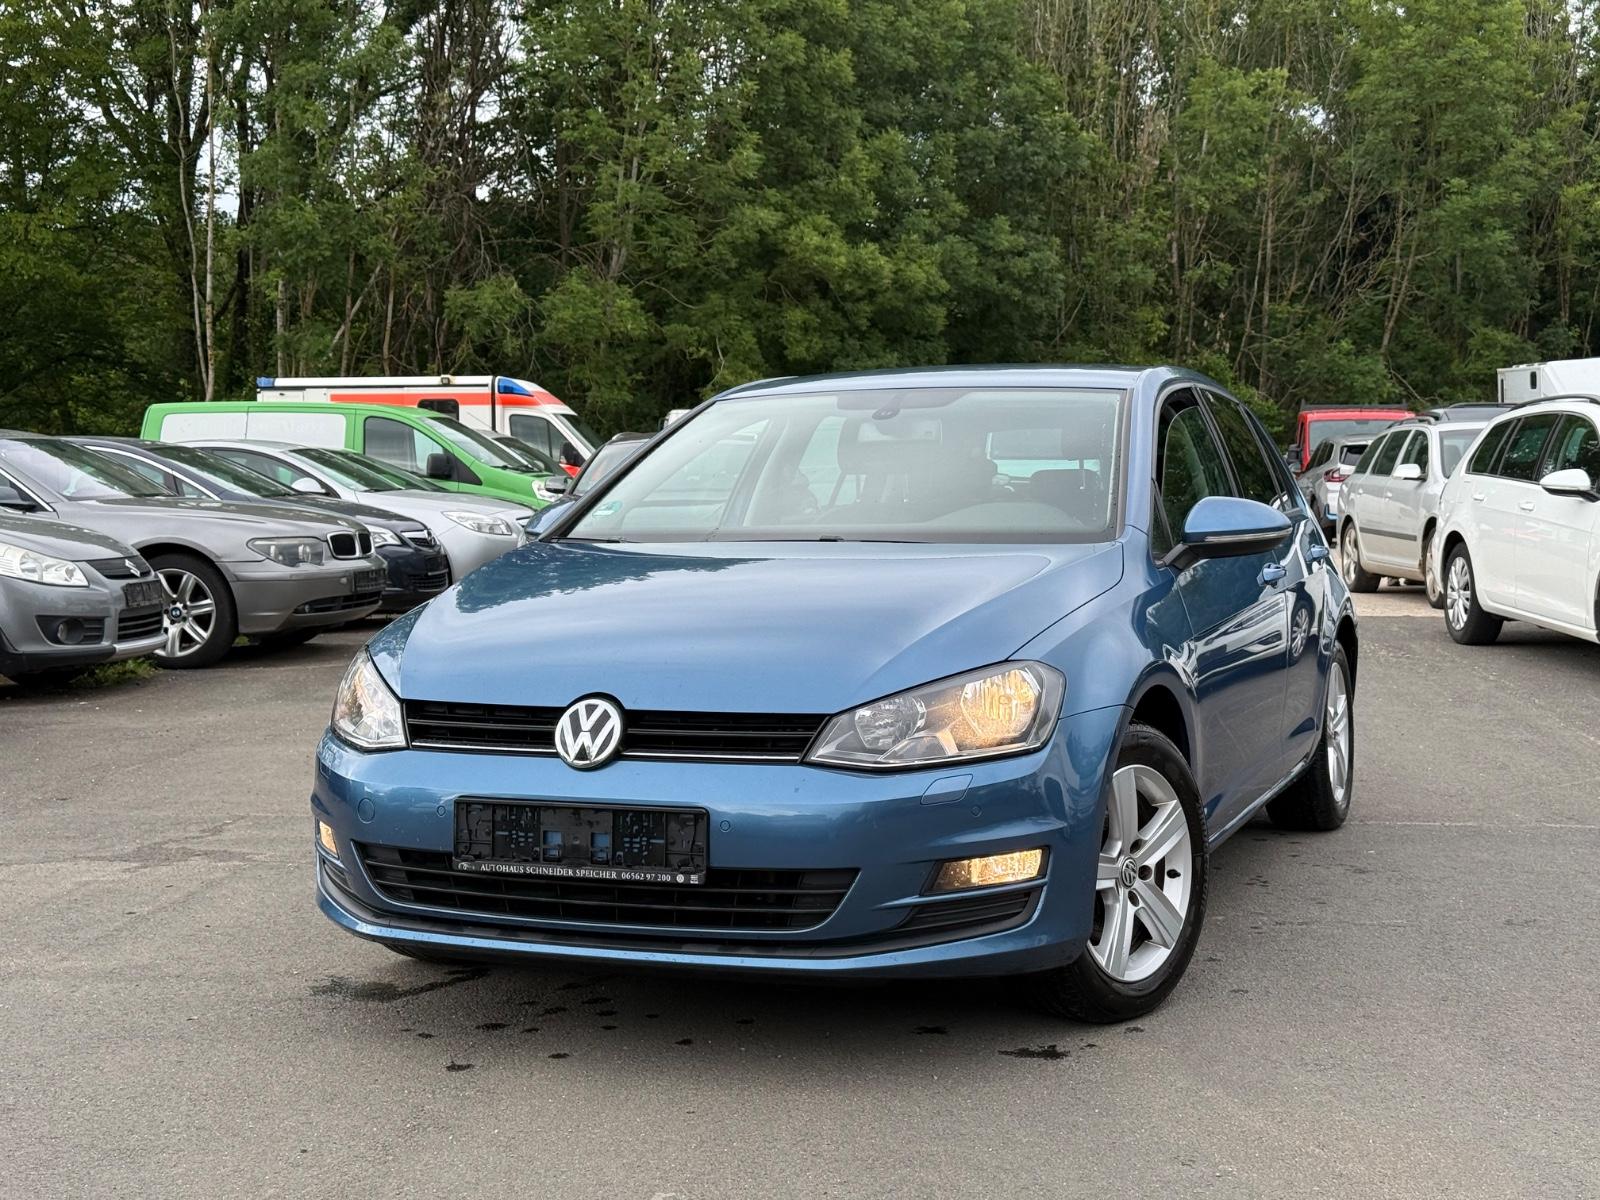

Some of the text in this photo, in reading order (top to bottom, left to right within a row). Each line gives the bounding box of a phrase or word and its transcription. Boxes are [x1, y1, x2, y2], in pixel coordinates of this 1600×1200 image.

[555, 699, 621, 766] VW
[480, 863, 524, 874] AUTOHAUS
[525, 866, 574, 877] SCHNEIDER
[575, 869, 617, 879] SPEICHER
[621, 872, 644, 881] 06562
[645, 873, 655, 881] 97
[657, 873, 671, 882] 200
